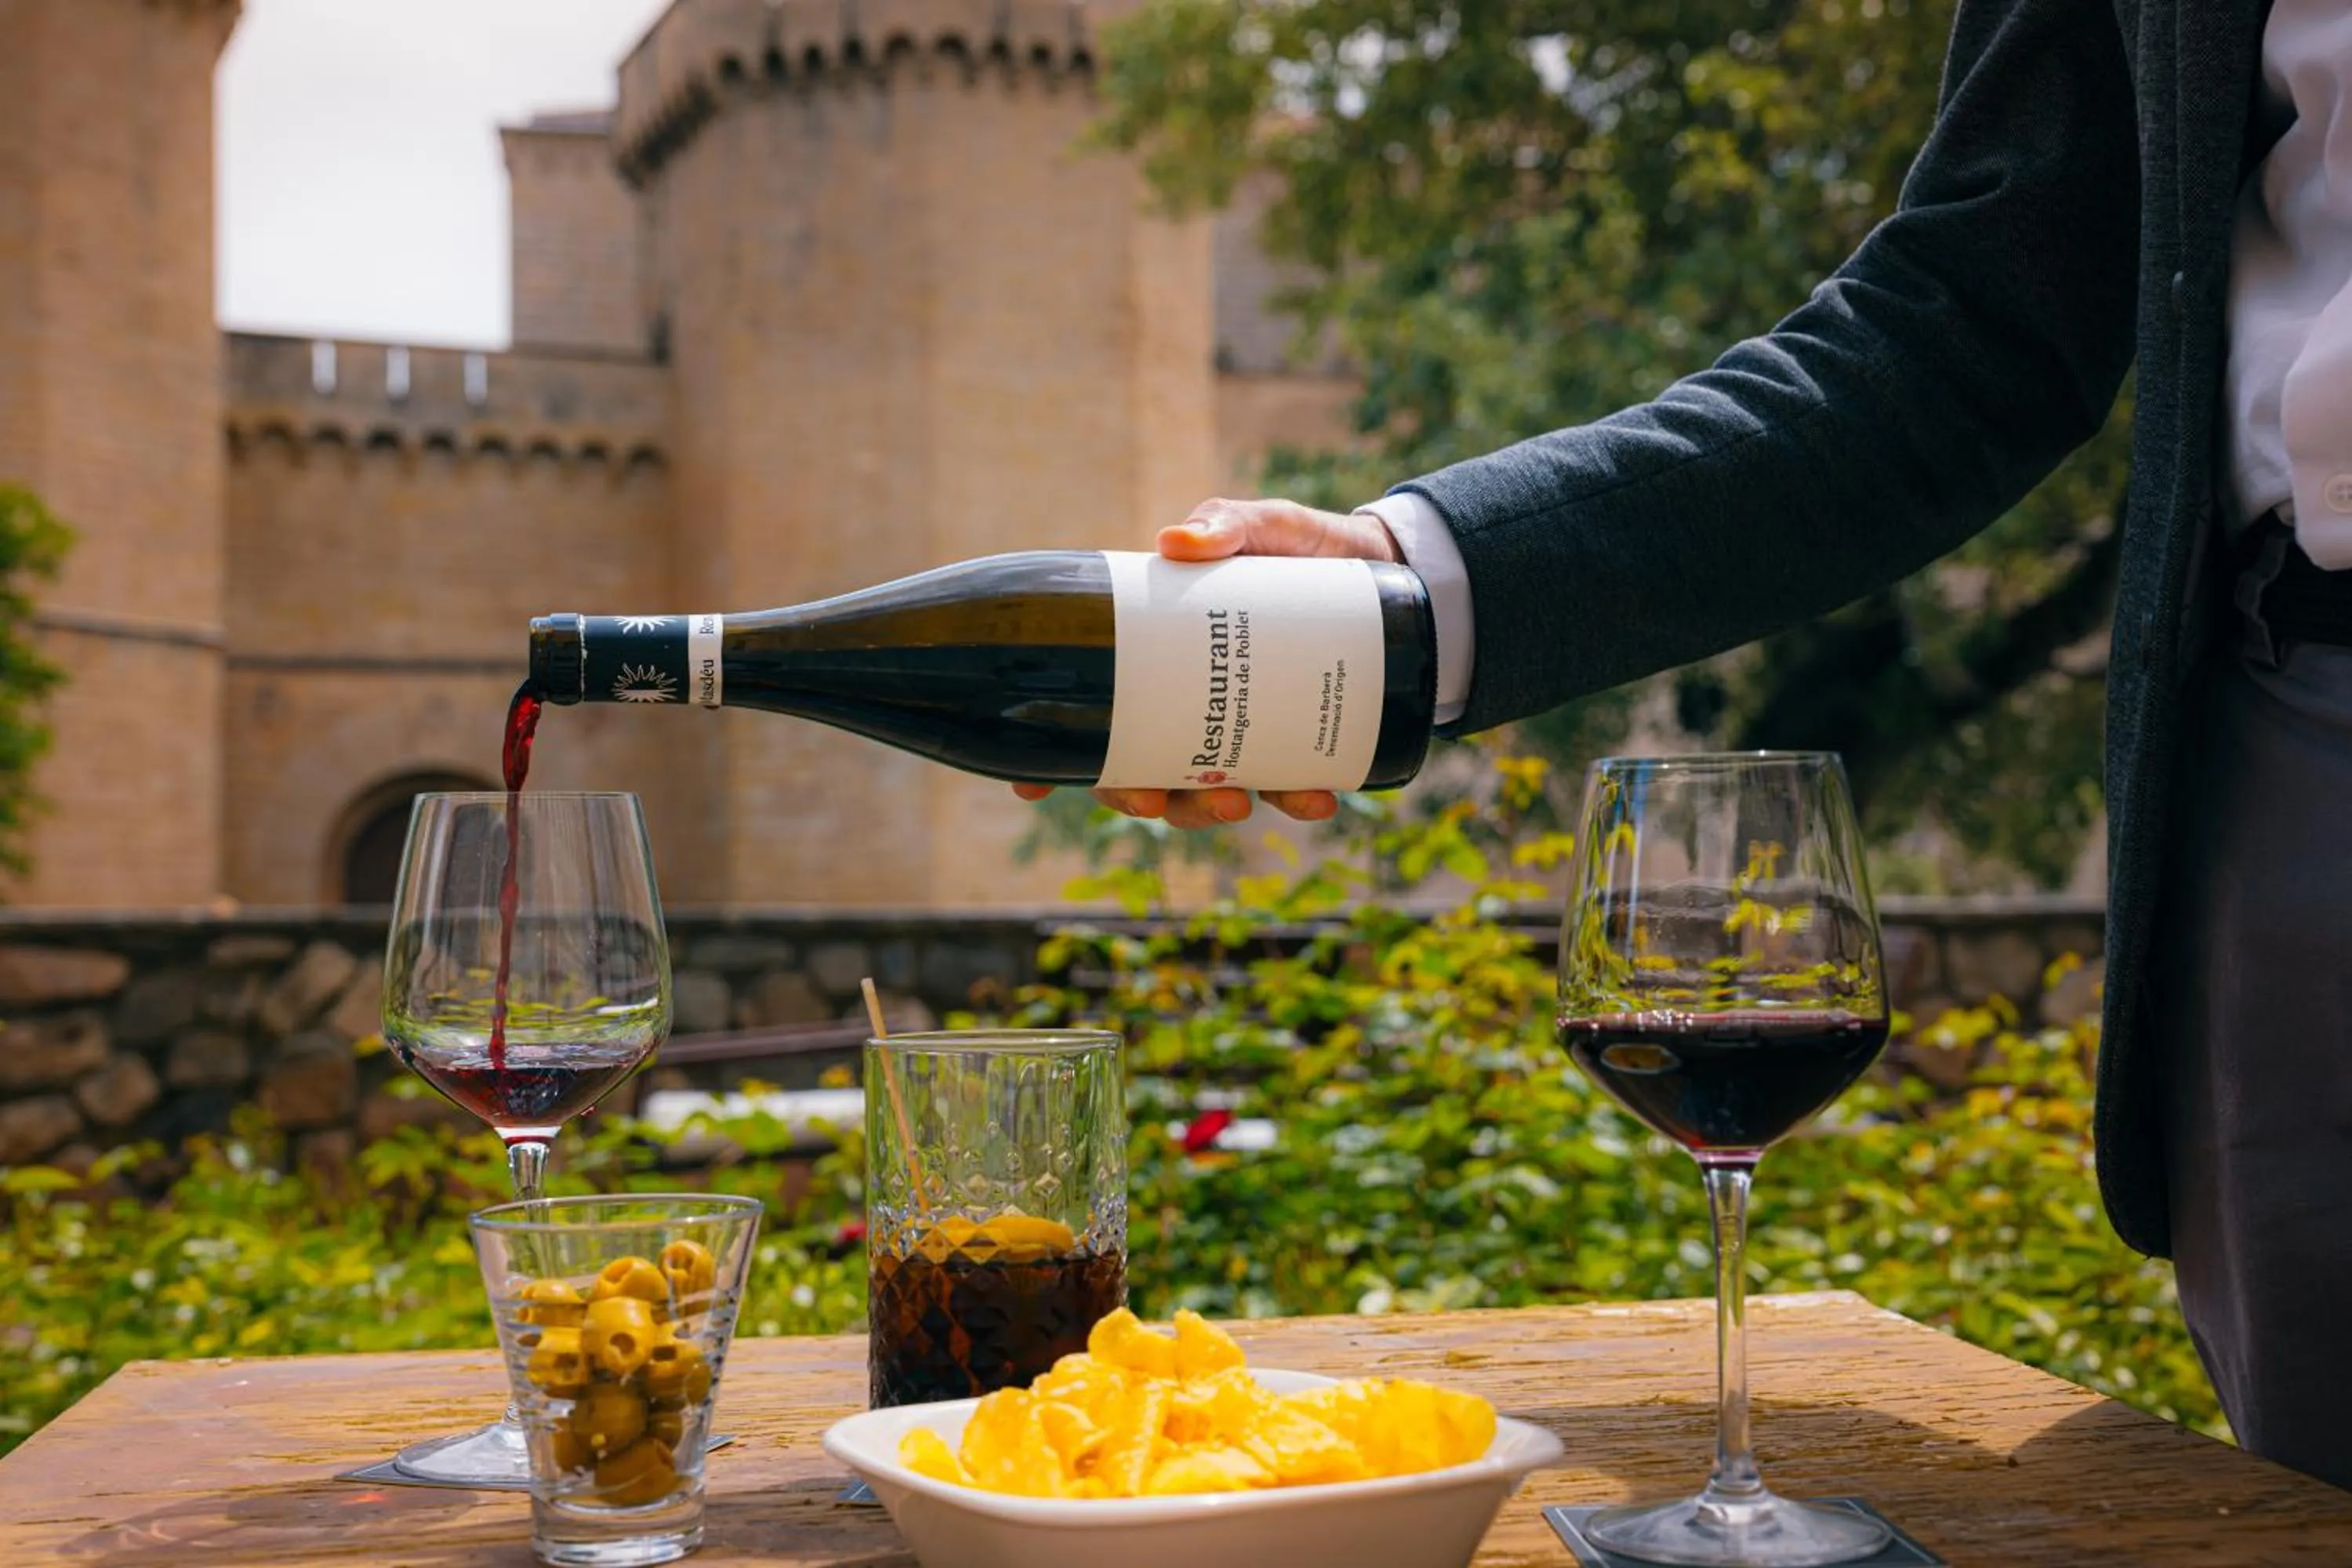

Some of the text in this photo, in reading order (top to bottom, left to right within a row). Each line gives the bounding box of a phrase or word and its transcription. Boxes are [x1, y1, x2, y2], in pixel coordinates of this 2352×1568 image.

[1191, 609, 1229, 768] Restaurant
[1222, 611, 1250, 768] Hostatgeria de Poblet
[1320, 713, 1329, 725] de
